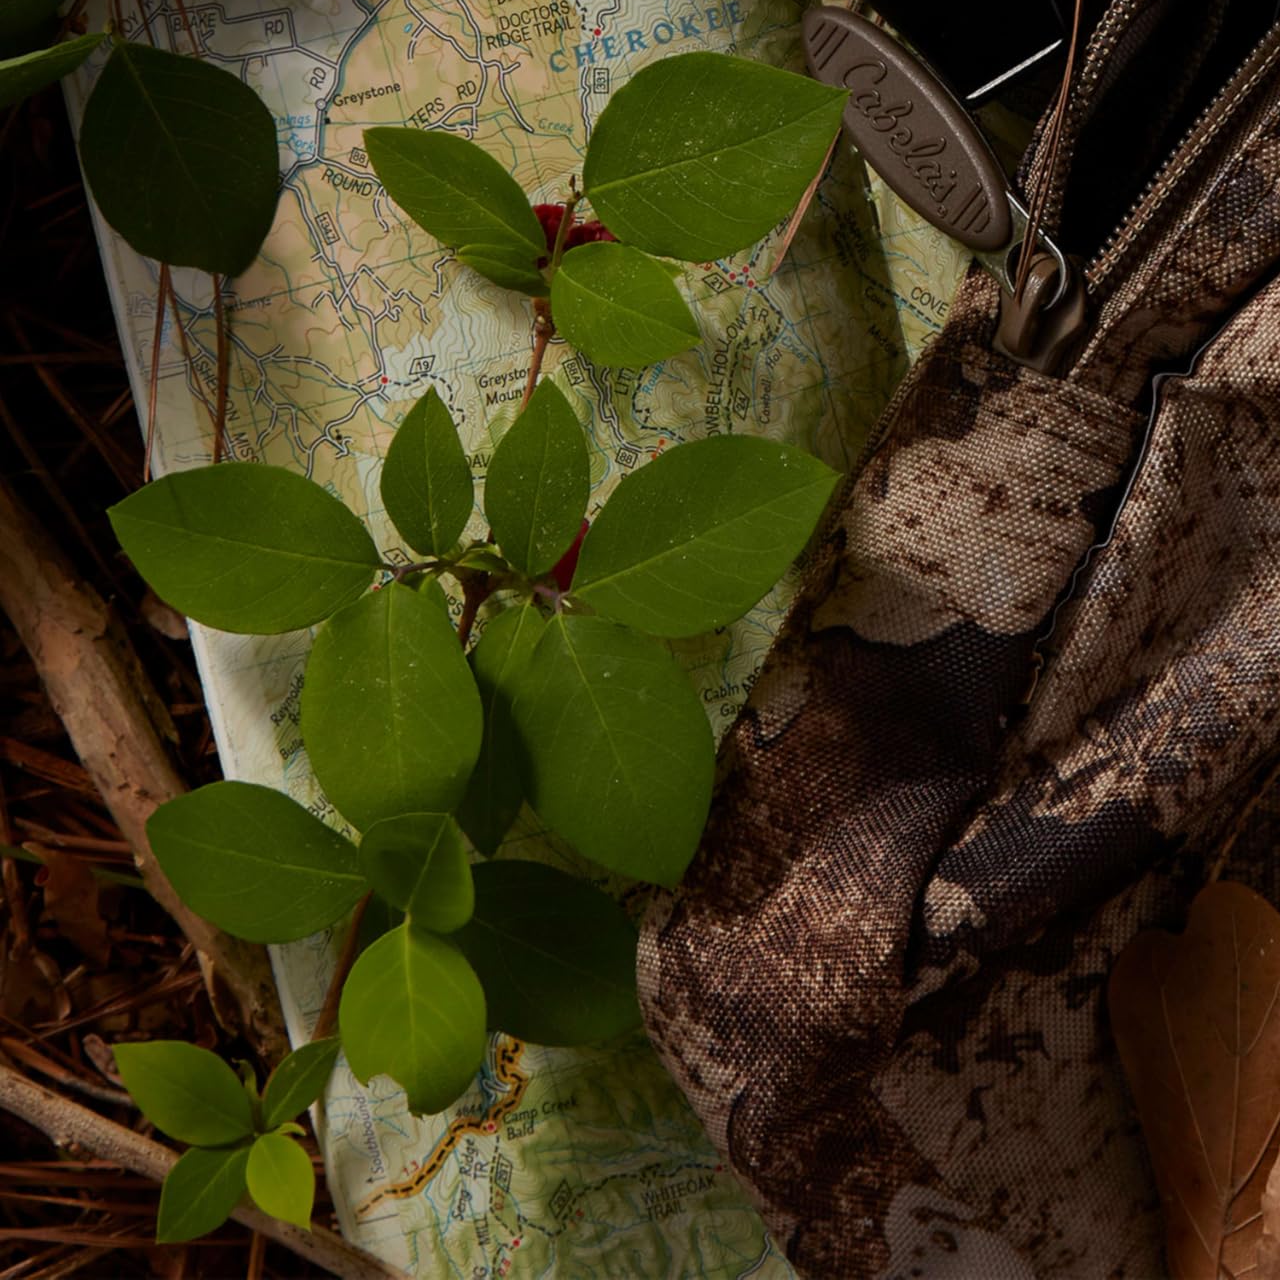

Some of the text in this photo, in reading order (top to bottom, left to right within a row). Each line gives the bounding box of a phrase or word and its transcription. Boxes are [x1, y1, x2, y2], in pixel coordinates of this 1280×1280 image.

[173, 12, 284, 37] BAKE RD
[499, 0, 571, 31] DOCTORS
[486, 16, 576, 51] RIDGE TRAIL
[549, 0, 745, 72] CHEROKEE
[310, 67, 327, 91] RD
[456, 80, 477, 101] RD
[332, 80, 402, 108] Greystone
[321, 169, 374, 197] ROUND
[317, 215, 337, 241] 1347
[911, 287, 949, 317] COVE
[748, 306, 770, 324] TR
[416, 360, 430, 371] 19
[619, 451, 634, 464] 88
[704, 685, 740, 702] Cabin
[502, 1108, 538, 1125] Camp
[354, 1093, 385, 1175] Southbound
[507, 1124, 535, 1141] Bald
[459, 1138, 479, 1176] Ridge
[474, 1161, 489, 1180] TR
[641, 1175, 717, 1205] WHITEOAK
